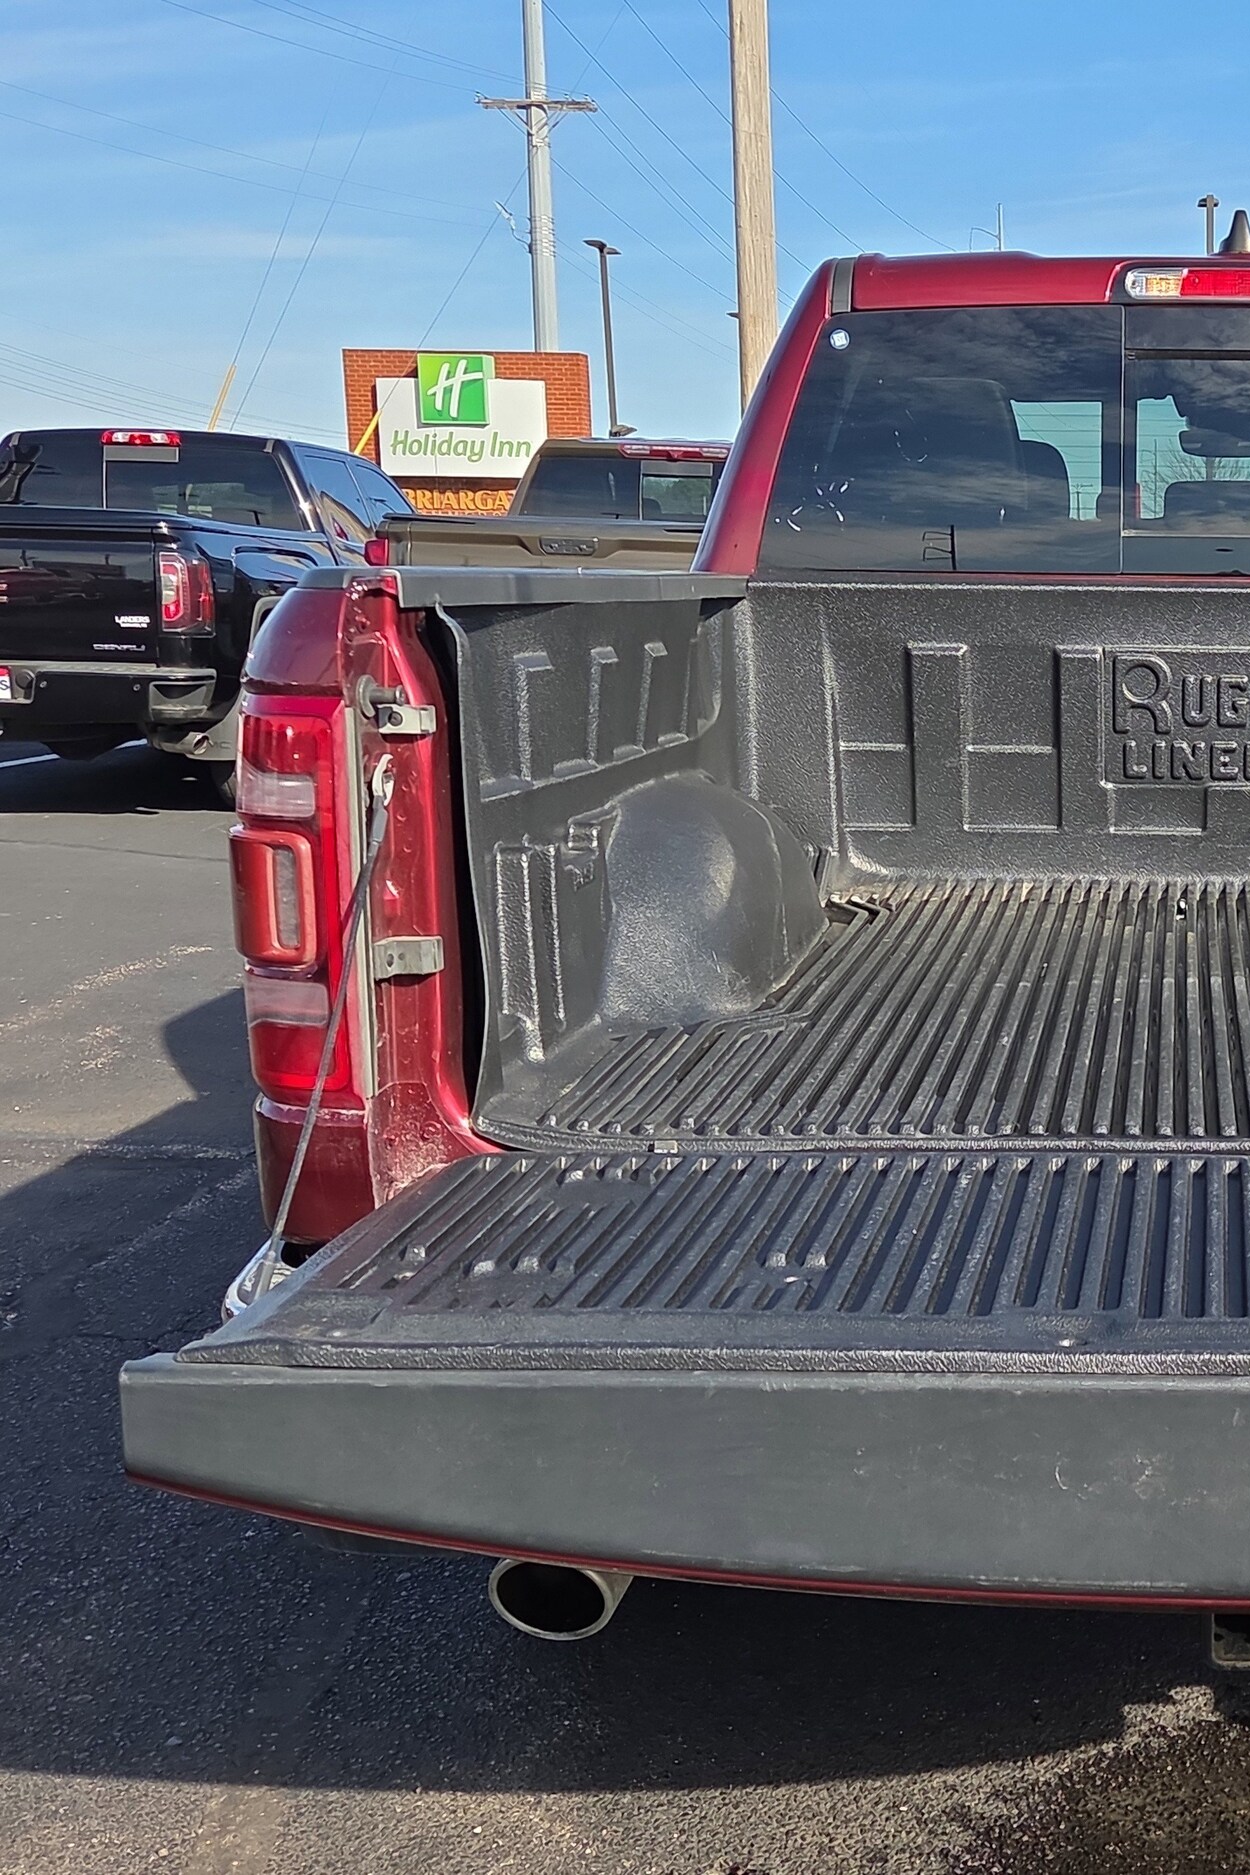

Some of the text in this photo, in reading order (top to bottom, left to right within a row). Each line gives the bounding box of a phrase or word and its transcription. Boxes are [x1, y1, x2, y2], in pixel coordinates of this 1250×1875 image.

[390, 430, 531, 463] Holiday Inn
[402, 488, 515, 510] BRIARGA
